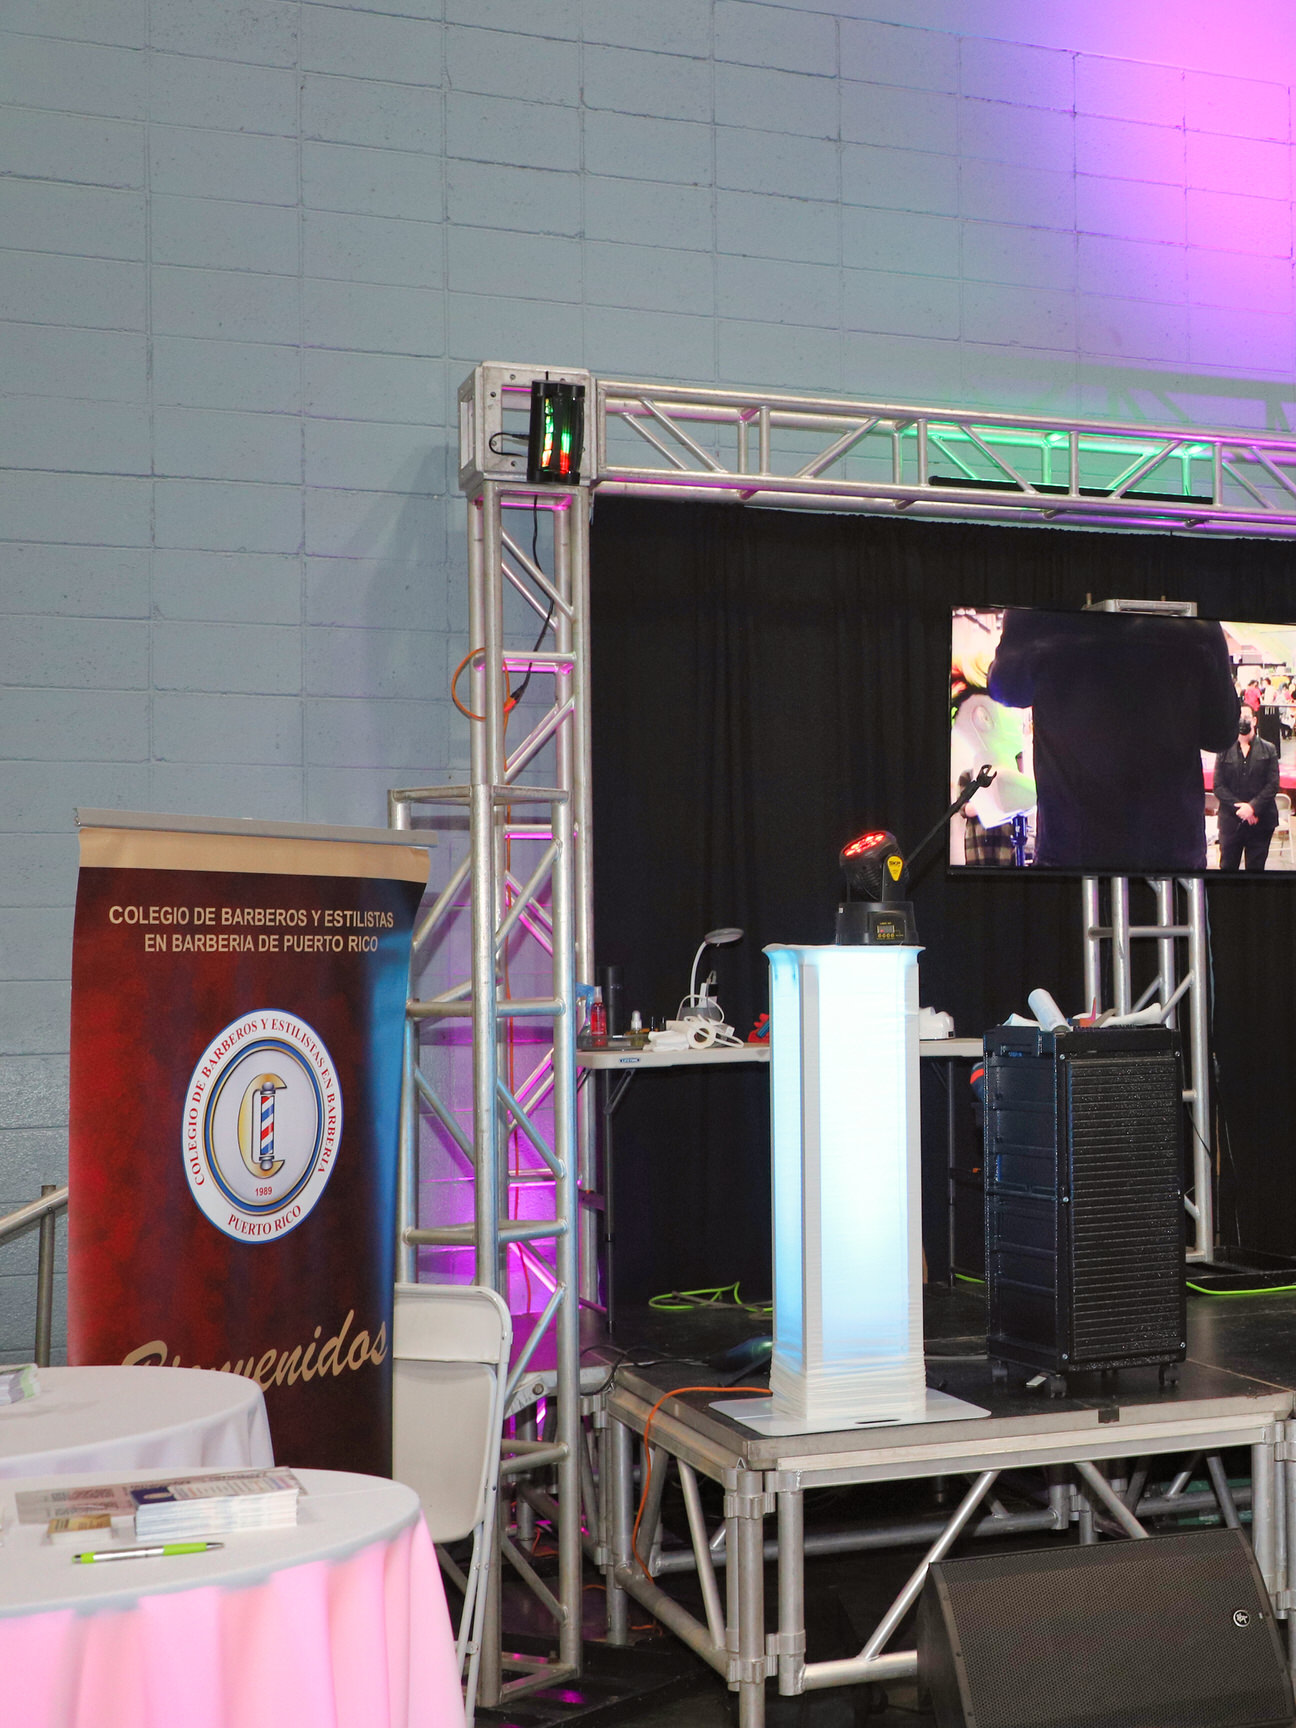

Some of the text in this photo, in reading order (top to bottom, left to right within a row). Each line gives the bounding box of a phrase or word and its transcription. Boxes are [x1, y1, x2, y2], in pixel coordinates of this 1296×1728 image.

[108, 905, 395, 928] COLEGIO DE BARBEROS Y ESTILISTAS
[144, 933, 379, 953] EN BARBERIA DE PUERTO RICO
[187, 1017, 337, 1187] COLEGIO DE BARBEROS Y ESTILISTAS EN BARBERIA
[255, 1186, 273, 1197] 1989
[227, 1204, 302, 1236] PUERTO RICO
[122, 1309, 388, 1392] enidos
